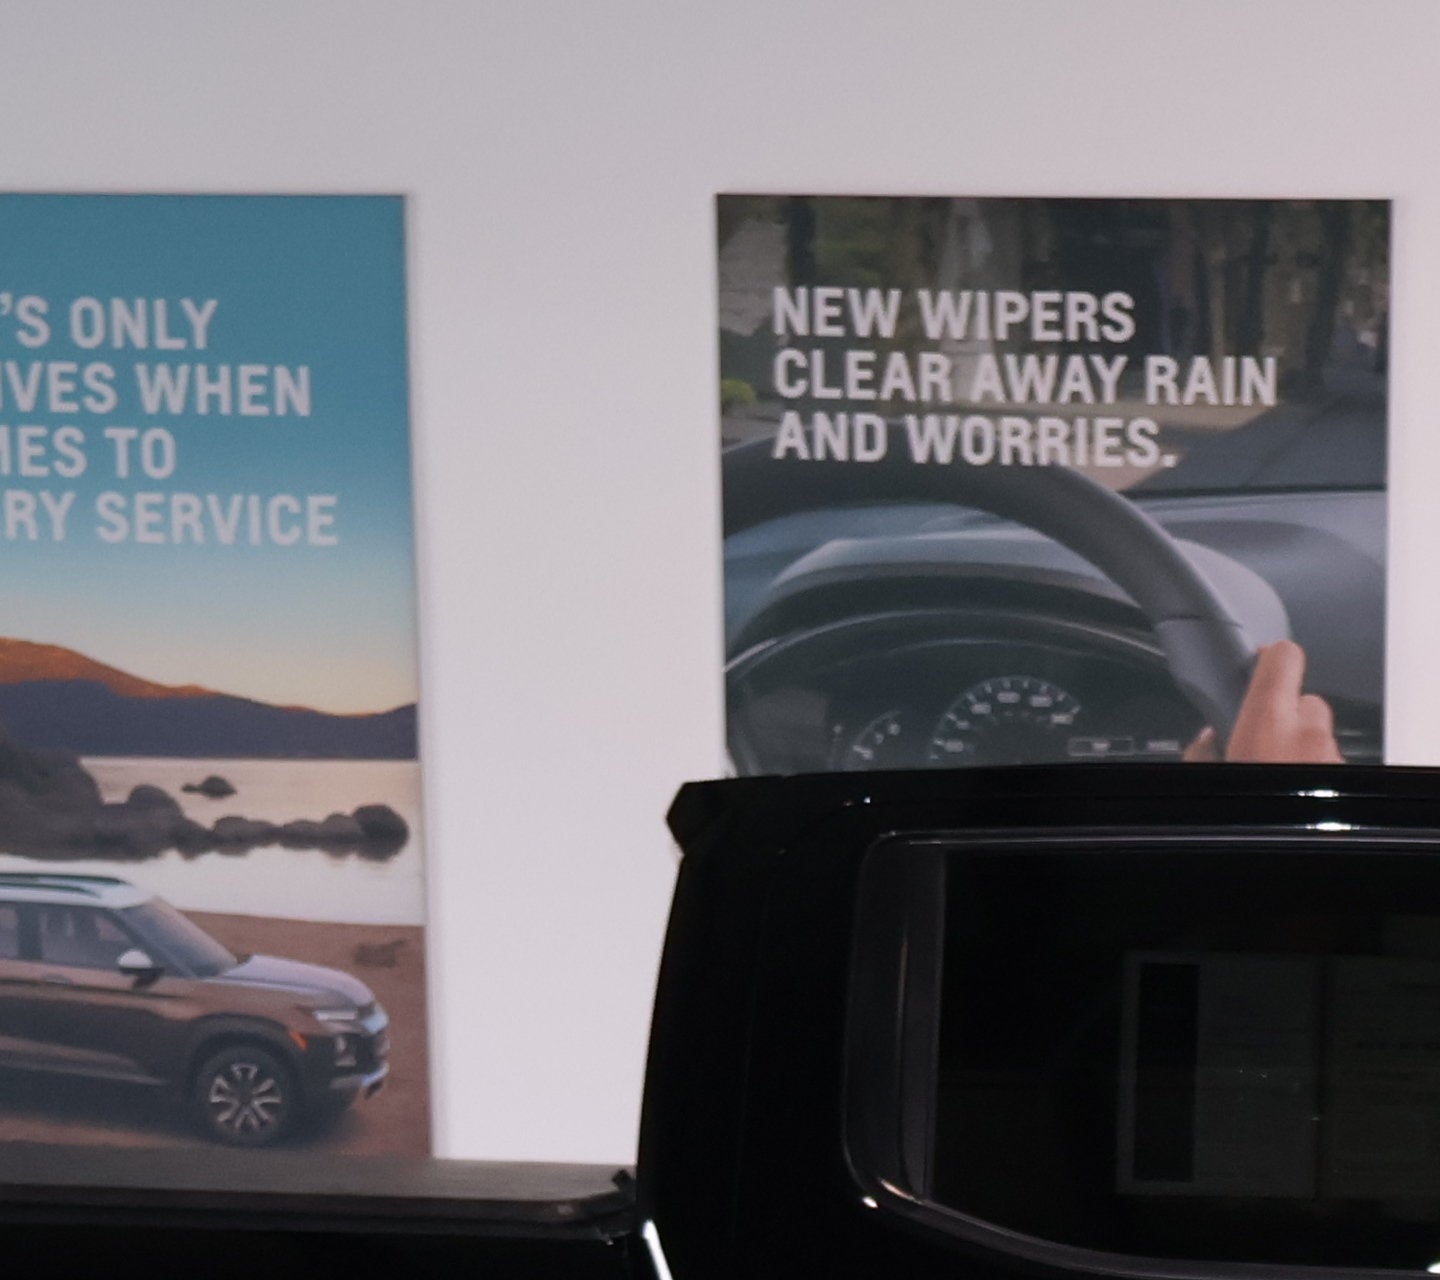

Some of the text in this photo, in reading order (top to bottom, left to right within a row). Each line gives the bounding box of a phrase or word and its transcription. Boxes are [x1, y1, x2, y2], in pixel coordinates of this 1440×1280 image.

[71, 297, 217, 349] ONLY
[773, 286, 1136, 343] NEW WIPERS
[136, 364, 310, 416] WHEN
[774, 349, 1276, 406] CLEAR AWAY RAIN
[105, 428, 175, 479] TO
[773, 412, 1177, 468] AND WORRIES.
[97, 493, 339, 547] SERVICE
